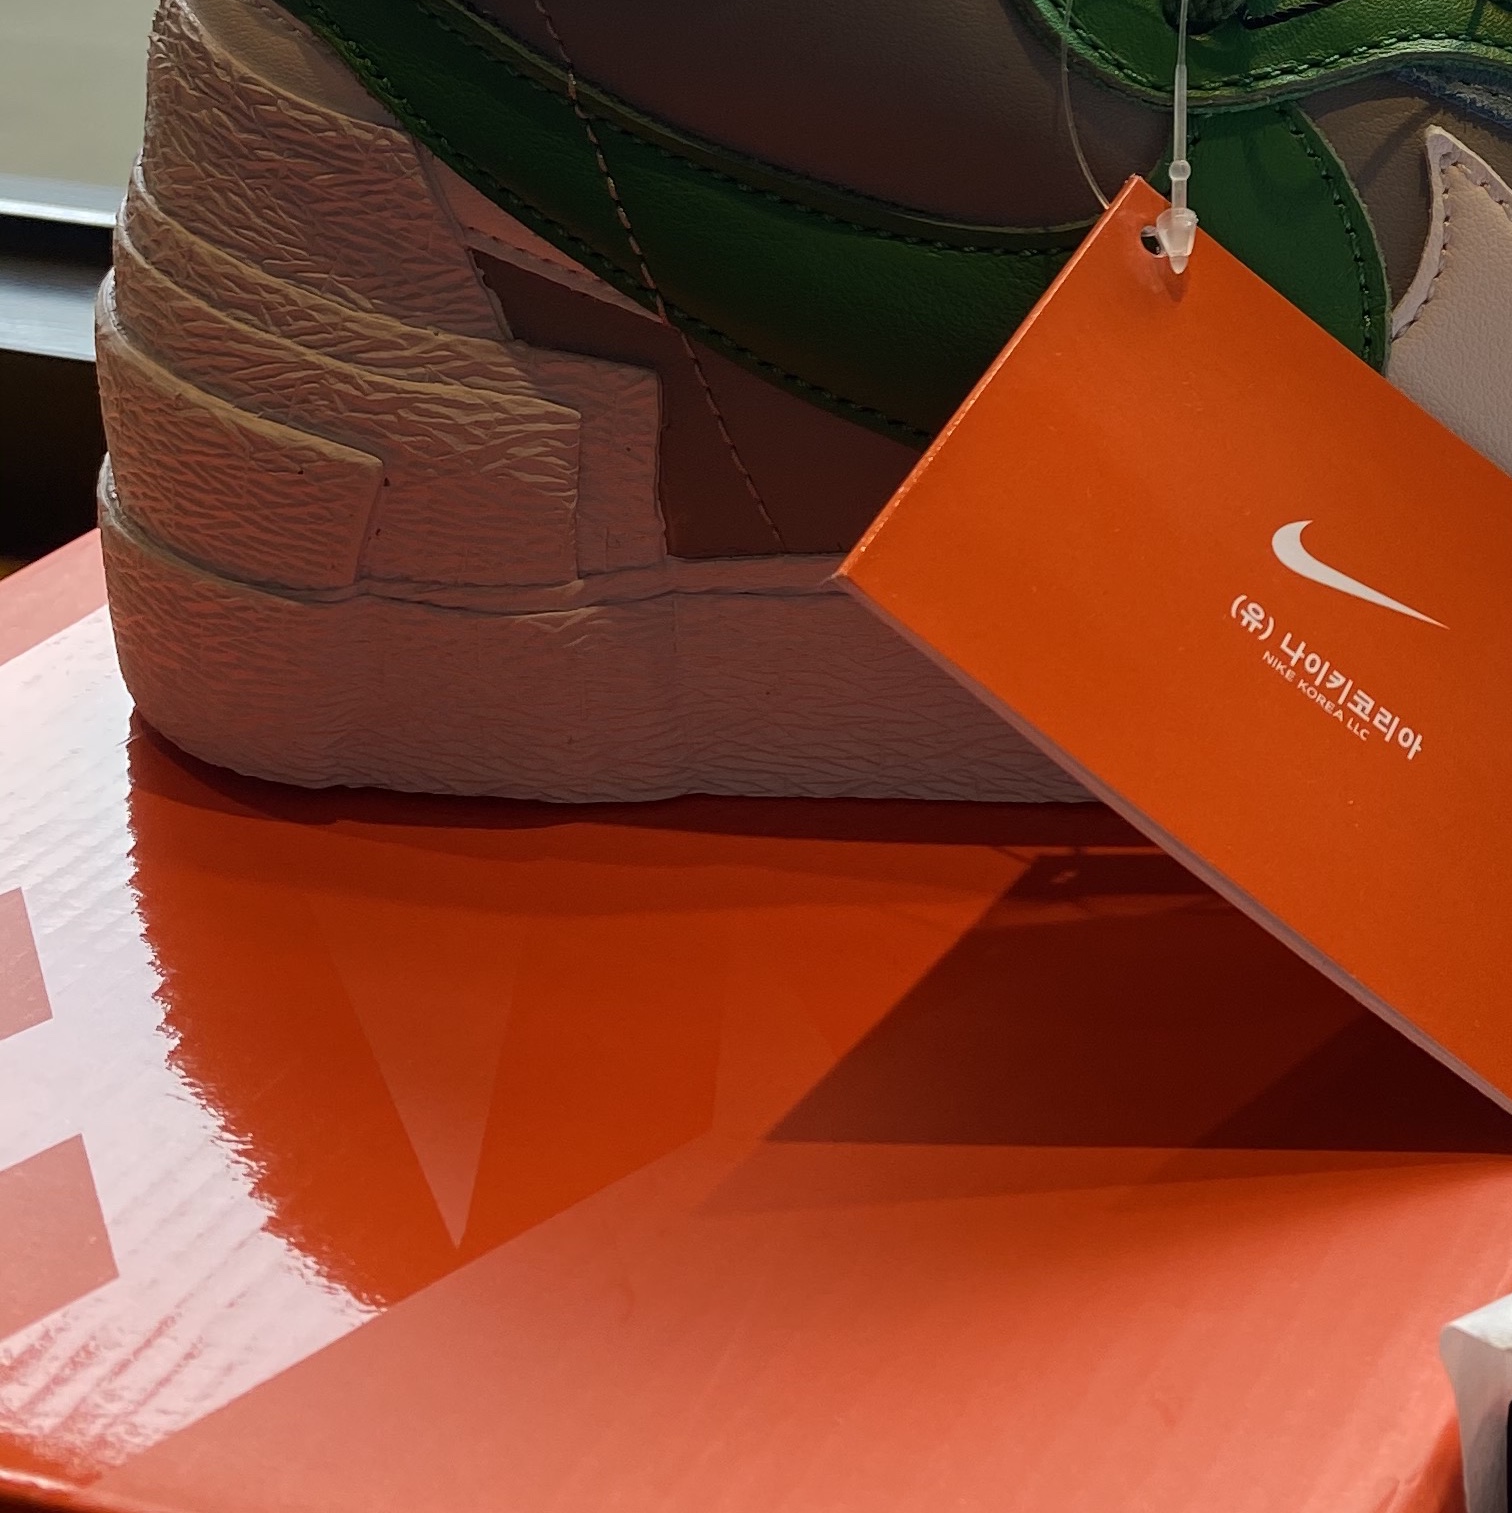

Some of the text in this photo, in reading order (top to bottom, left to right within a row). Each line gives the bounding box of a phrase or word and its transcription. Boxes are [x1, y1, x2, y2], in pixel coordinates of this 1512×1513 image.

[1230, 594, 1423, 761] (유) 나이키코리아
[1262, 650, 1370, 741] NIKE KOREA LLC
